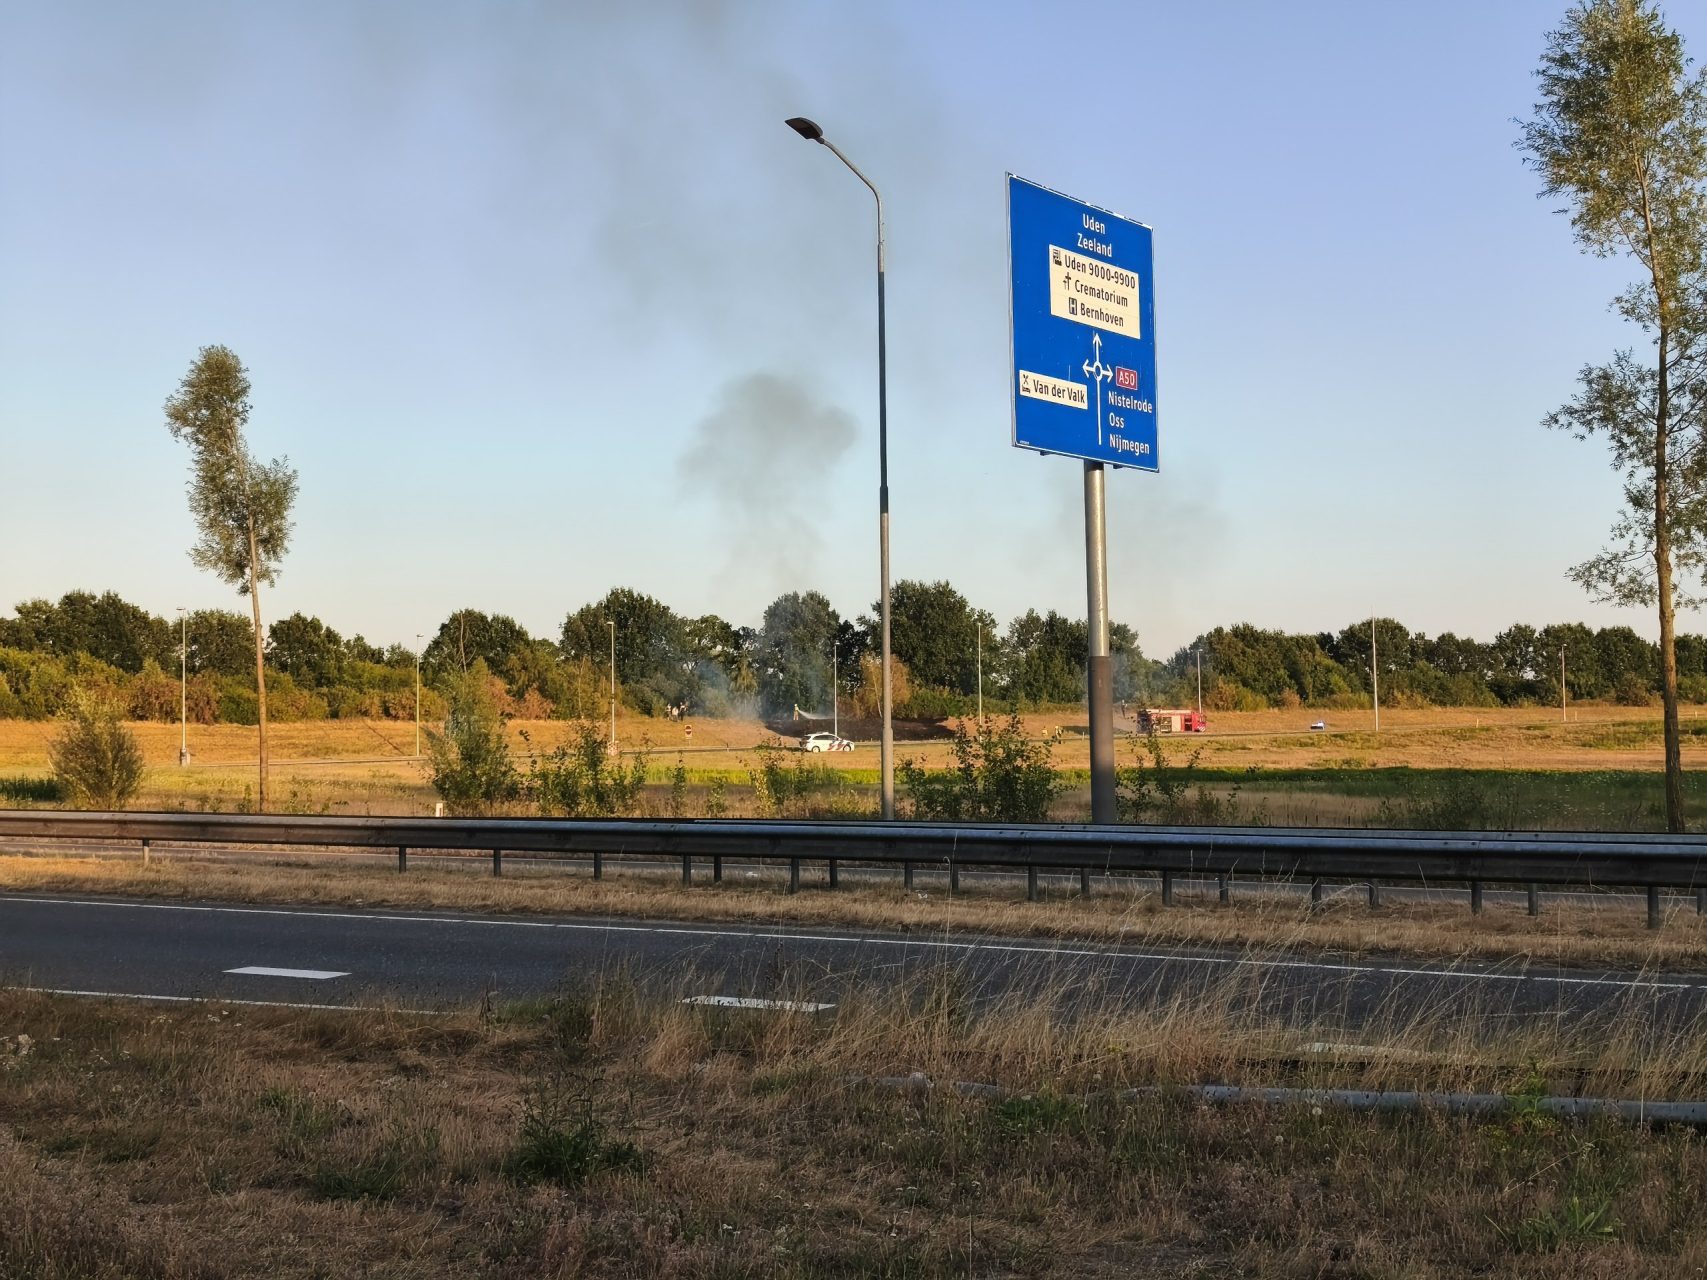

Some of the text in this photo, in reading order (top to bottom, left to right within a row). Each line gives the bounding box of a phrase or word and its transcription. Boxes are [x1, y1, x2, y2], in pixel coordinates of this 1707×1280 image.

[1082, 213, 1106, 235] Uden
[1077, 232, 1113, 258] Zeeland
[1064, 254, 1136, 289] Uden 9000-9900
[1074, 279, 1128, 307] Crematorium
[1080, 303, 1124, 327] Bernhoven
[1118, 371, 1135, 386] A50
[1032, 379, 1085, 404] Van der Valk
[1108, 390, 1153, 414] Nistelrode
[1109, 412, 1125, 429] Oss
[1109, 433, 1150, 456] Nijmegen
